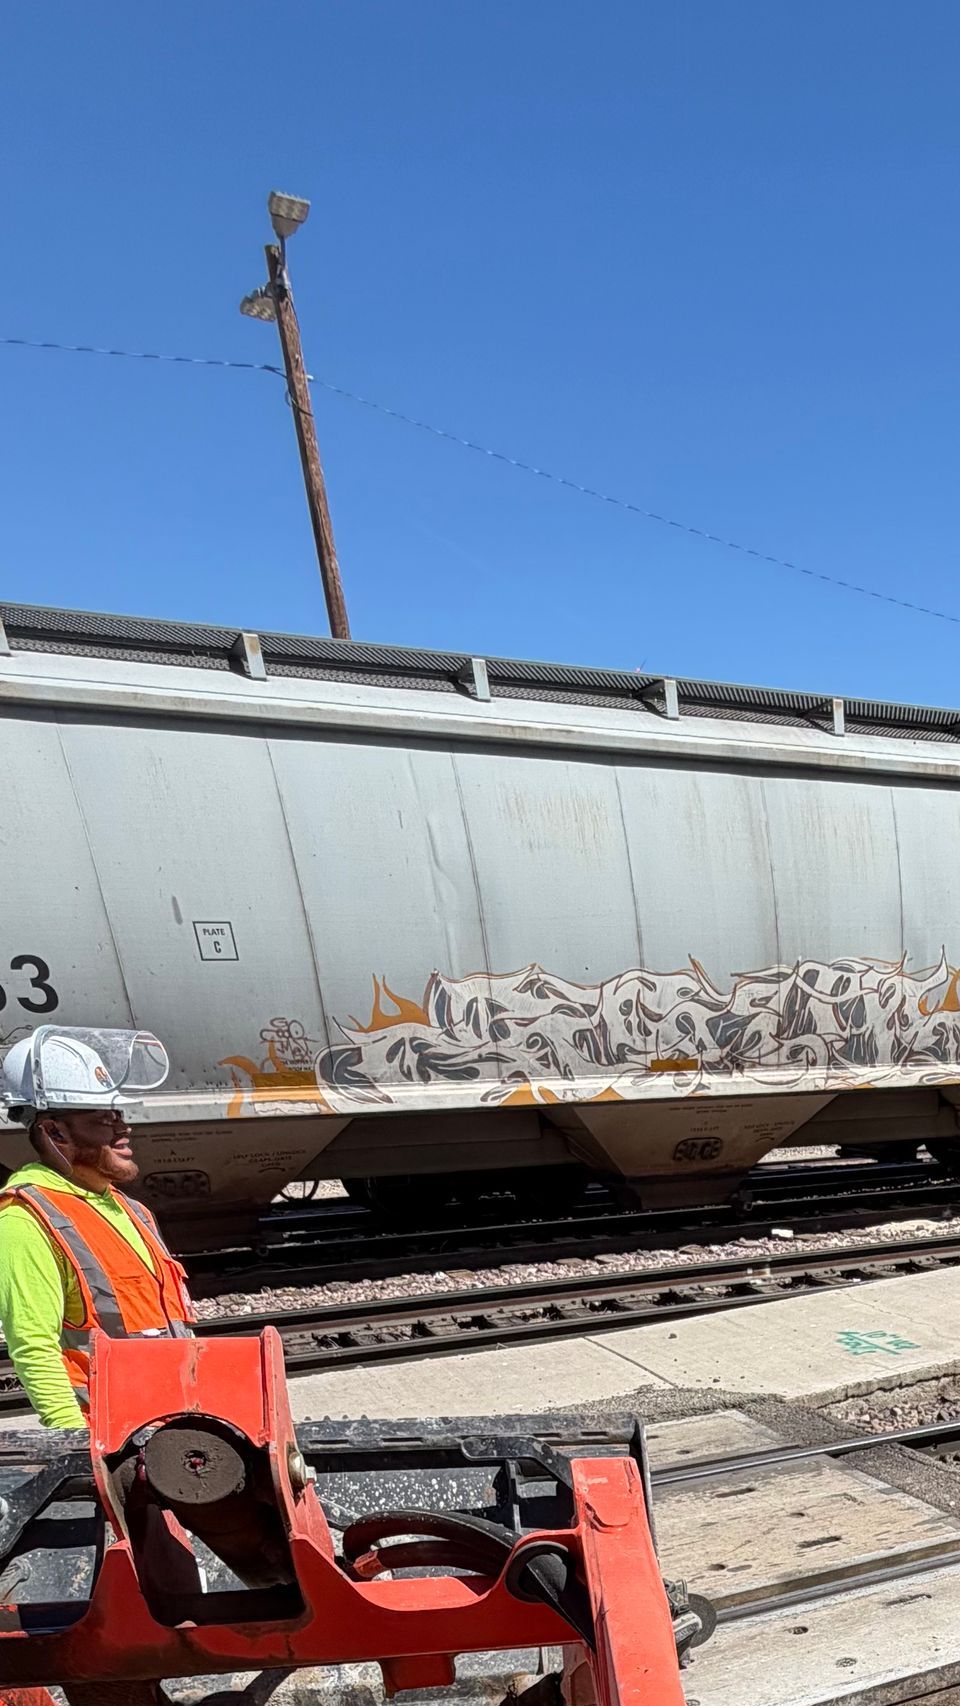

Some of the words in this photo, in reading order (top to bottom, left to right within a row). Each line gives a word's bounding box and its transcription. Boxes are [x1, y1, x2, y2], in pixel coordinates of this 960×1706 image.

[202, 928, 226, 936] PLATE
[213, 941, 222, 953] C
[0, 954, 59, 1014] 3
